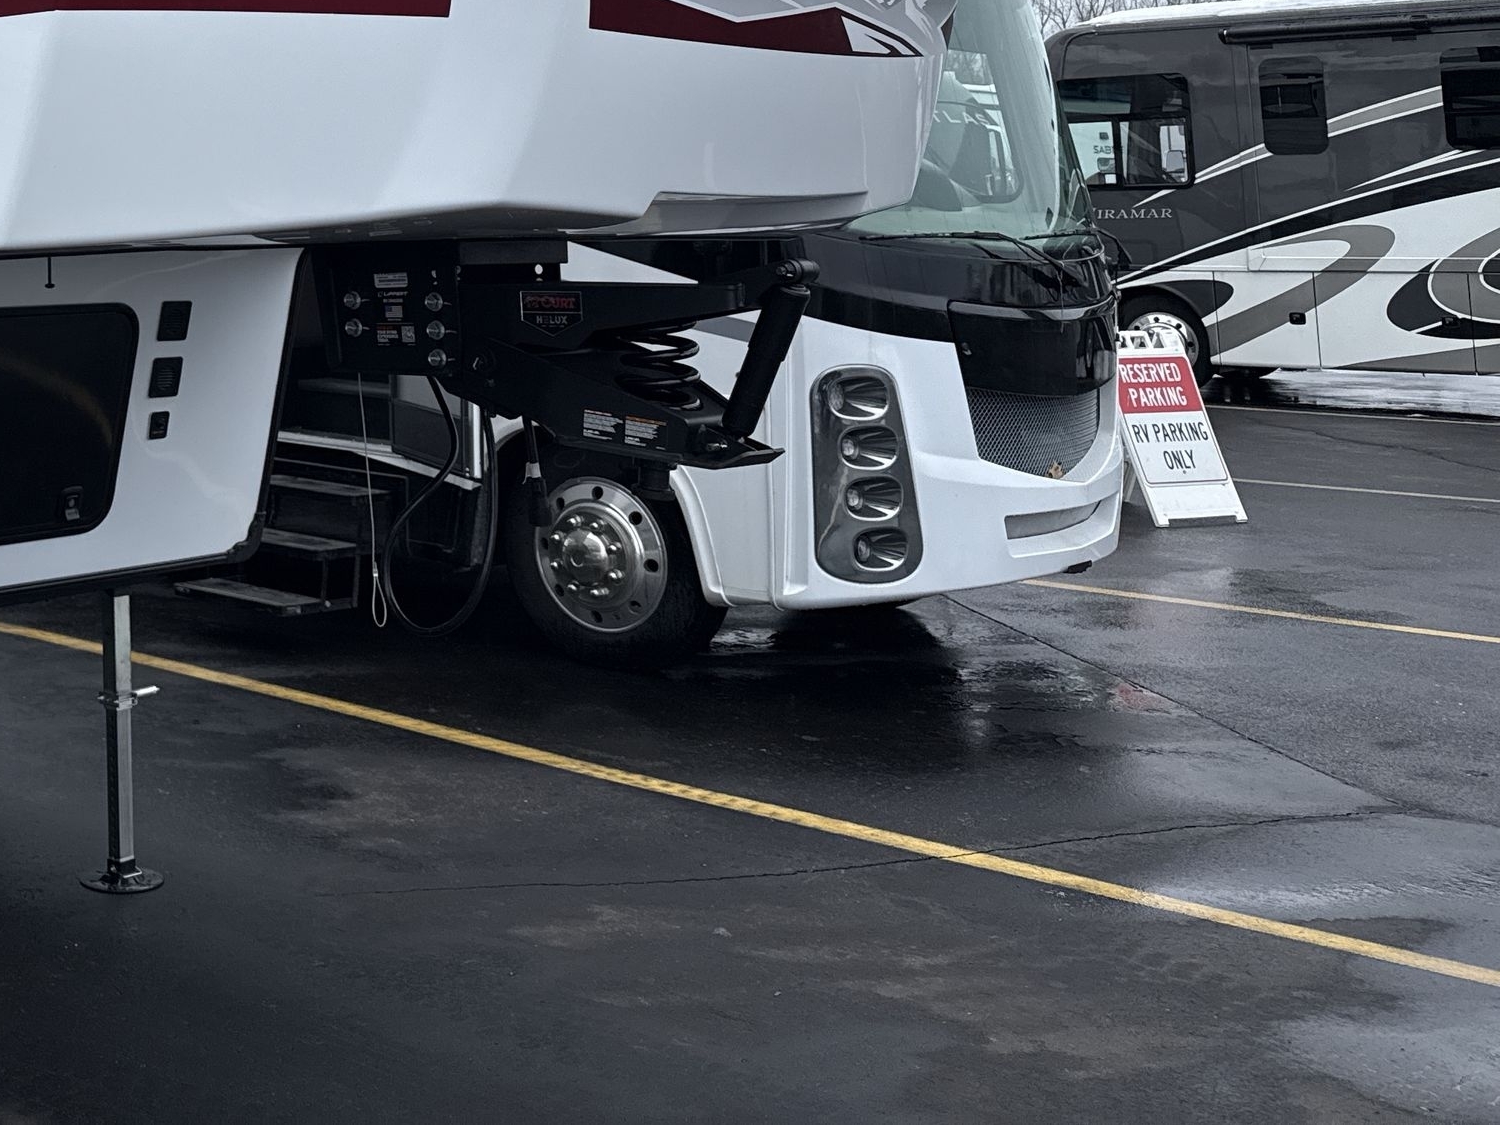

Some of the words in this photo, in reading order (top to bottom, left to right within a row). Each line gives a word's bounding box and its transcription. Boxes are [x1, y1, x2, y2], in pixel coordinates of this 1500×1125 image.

[1092, 207, 1172, 220] IRAMAR
[535, 315, 569, 325] HELUX
[1118, 361, 1182, 384] RESERVED
[1128, 385, 1188, 408] PARKING
[1131, 423, 1150, 444] RV
[1152, 421, 1209, 444] PARKING
[1163, 449, 1197, 471] ONLY
